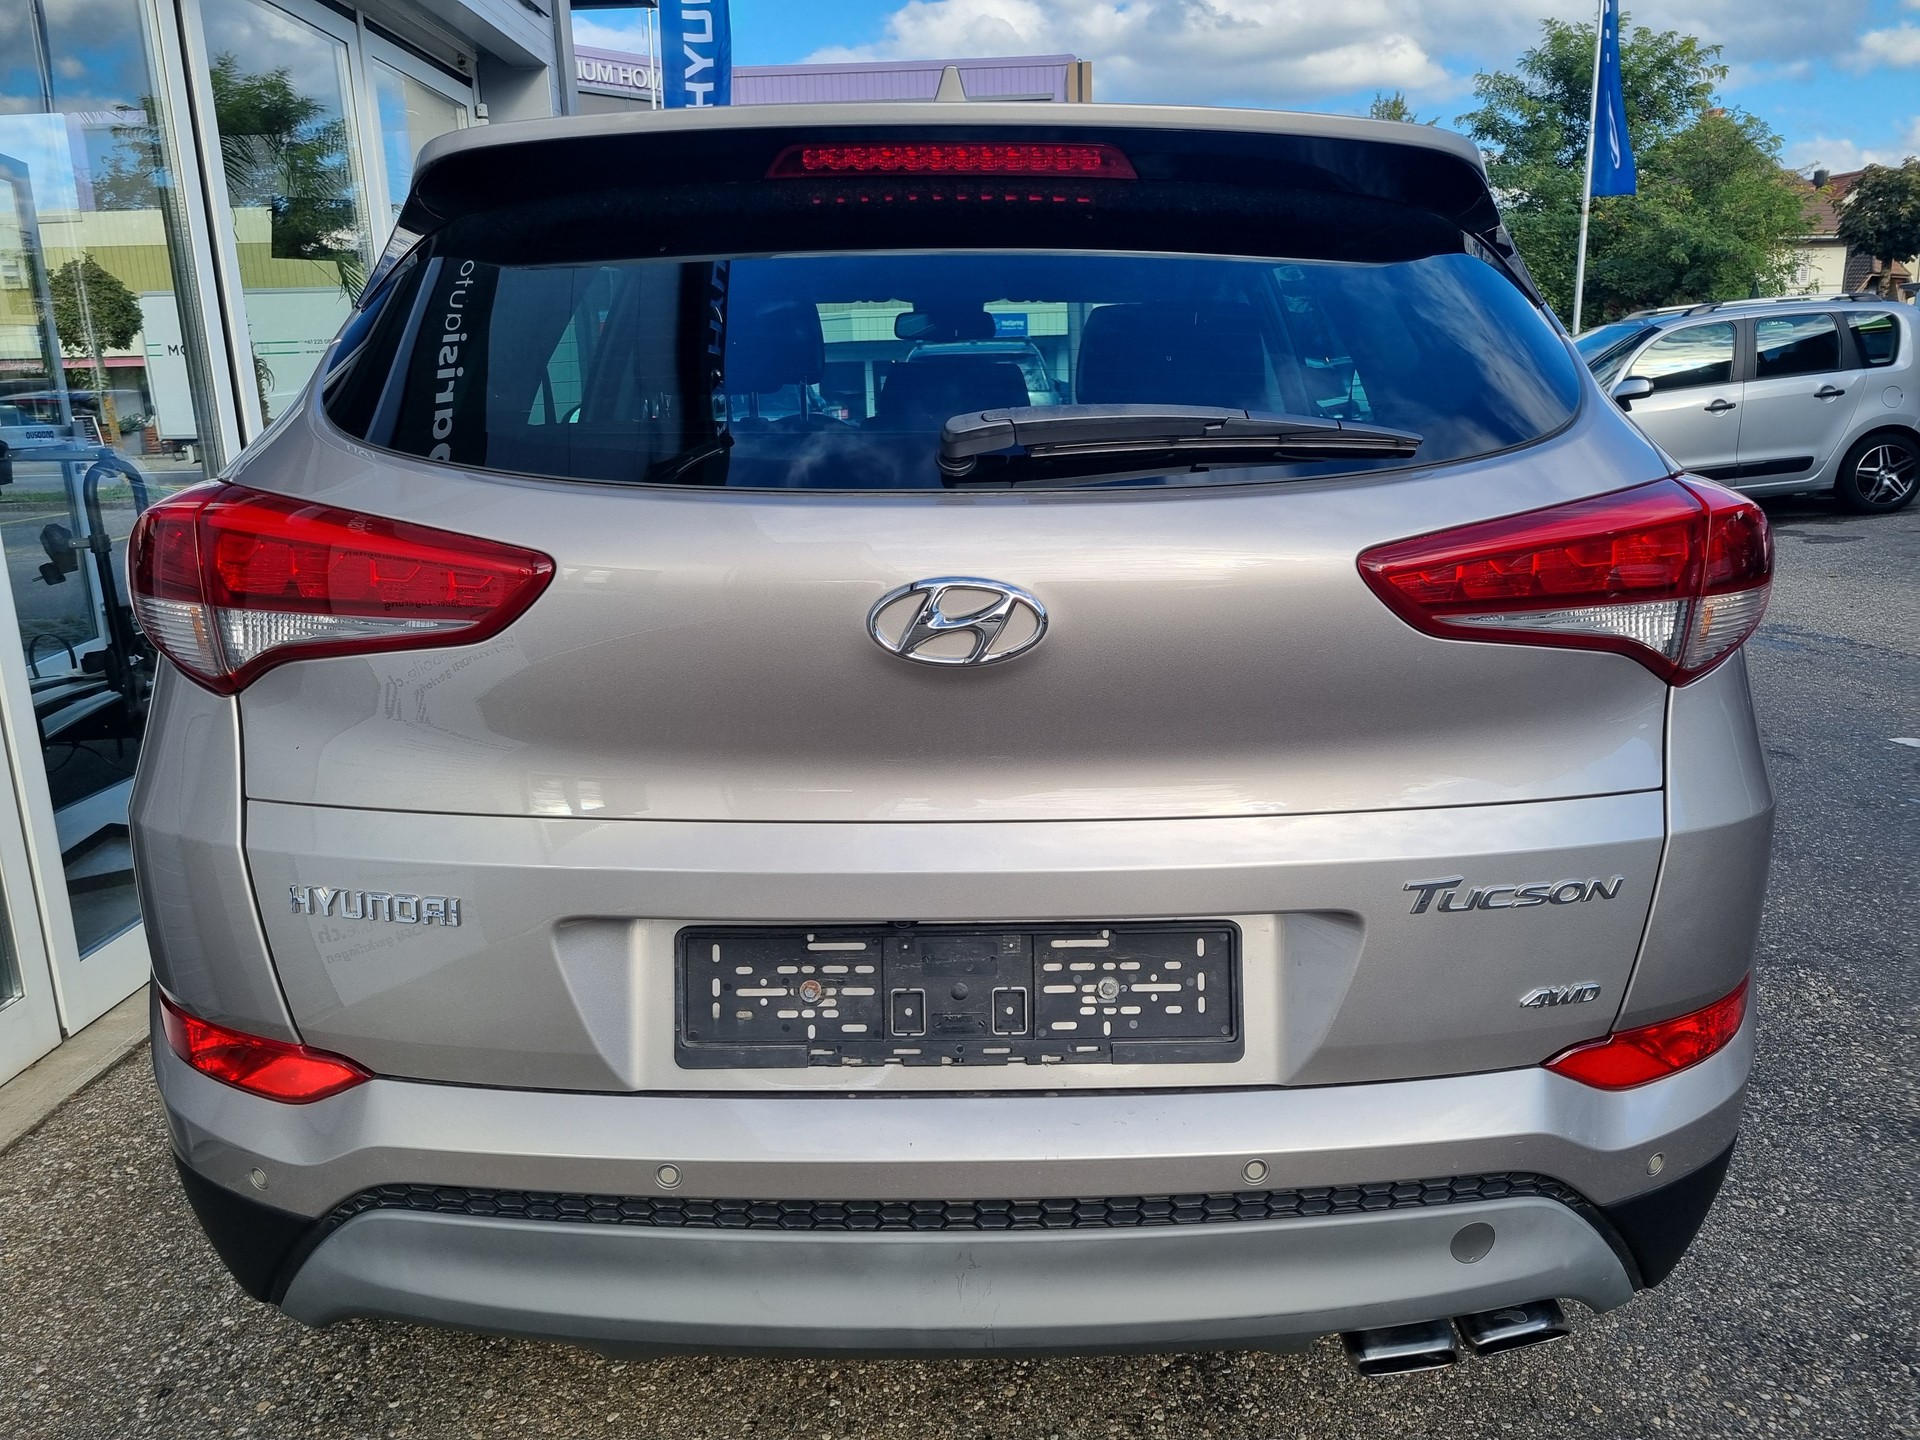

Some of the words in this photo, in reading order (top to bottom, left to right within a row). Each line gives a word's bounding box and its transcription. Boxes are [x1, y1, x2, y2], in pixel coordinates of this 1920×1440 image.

[681, 0, 714, 108] HYU
[289, 884, 461, 928] HYUNDAI
[1402, 874, 1625, 914] TUCSON
[1519, 981, 1602, 1009] 4WD
